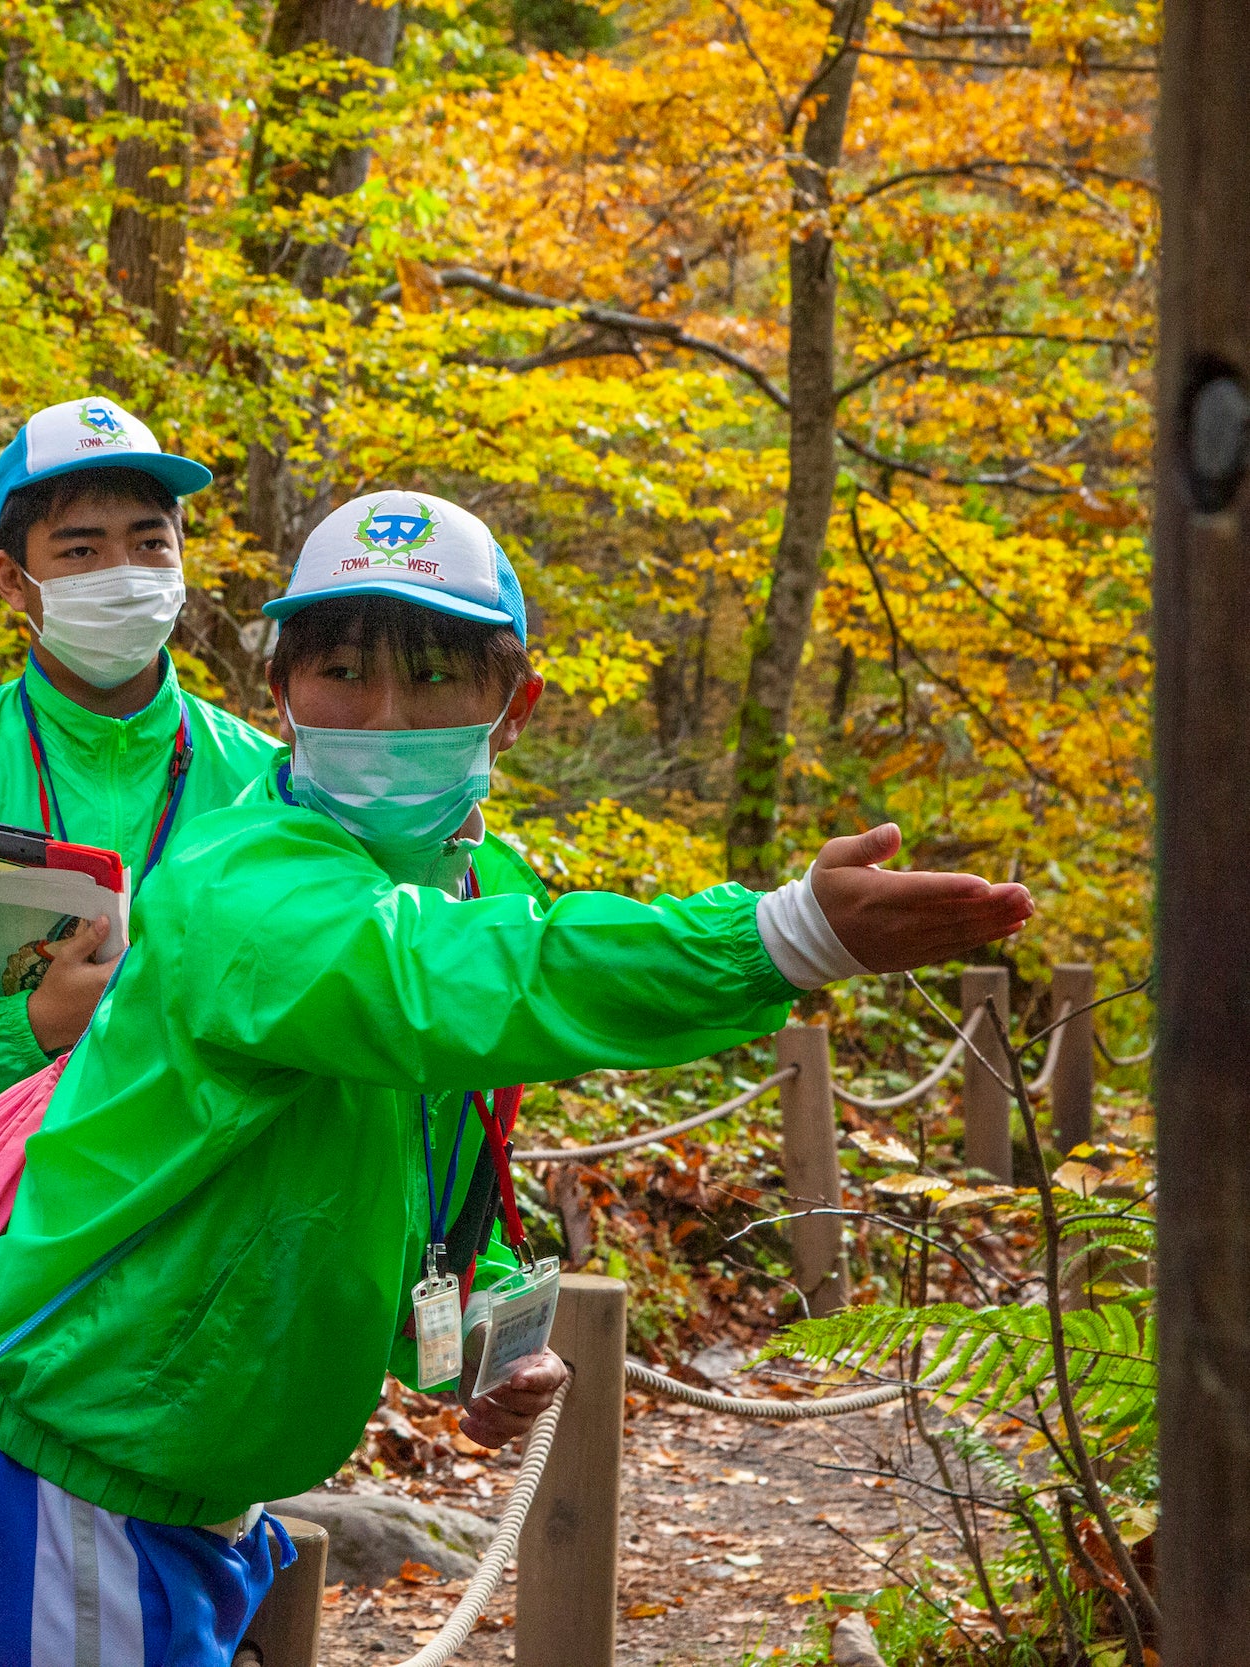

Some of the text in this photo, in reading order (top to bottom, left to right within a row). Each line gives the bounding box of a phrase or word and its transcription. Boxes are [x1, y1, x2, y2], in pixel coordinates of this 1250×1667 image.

[78, 437, 104, 448] TOWA
[341, 557, 440, 575] TOWA WEST
